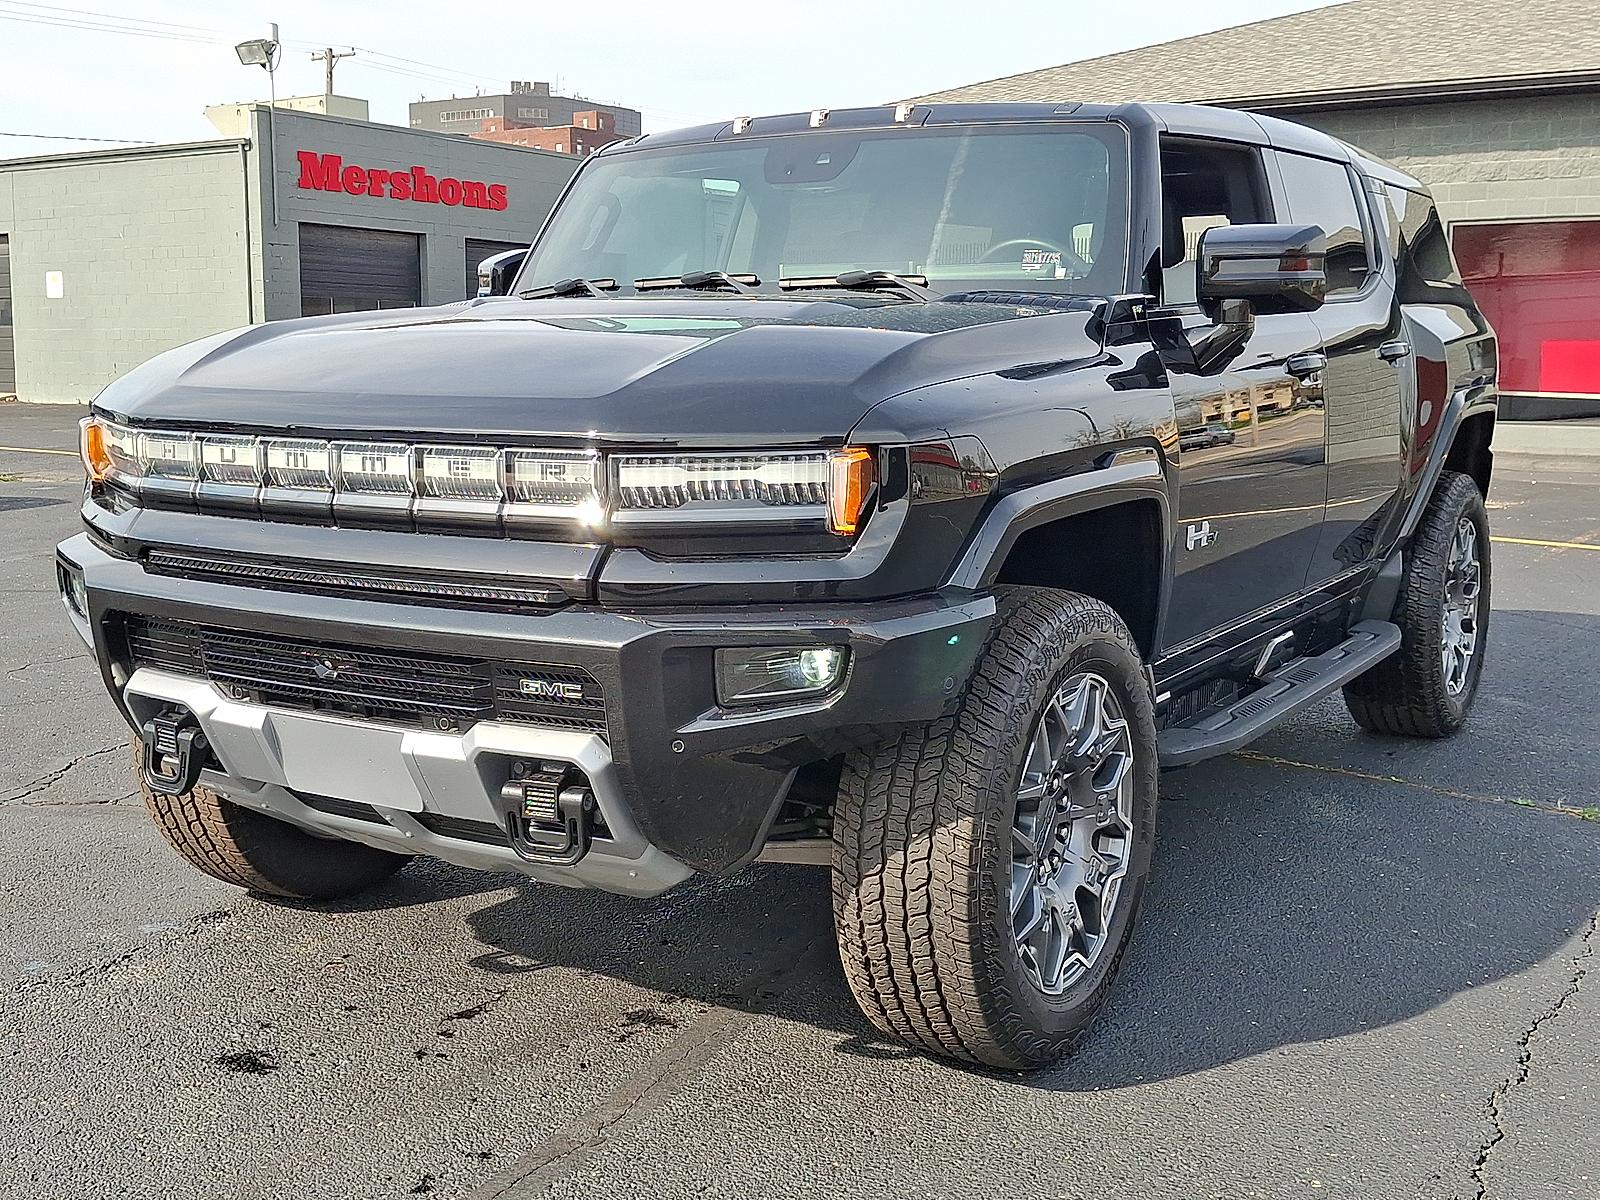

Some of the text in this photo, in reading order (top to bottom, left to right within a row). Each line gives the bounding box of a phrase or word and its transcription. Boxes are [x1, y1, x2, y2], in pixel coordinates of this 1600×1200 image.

[297, 150, 508, 211] Mershons
[162, 442, 566, 481] HUMMER
[519, 679, 583, 699] GMC
